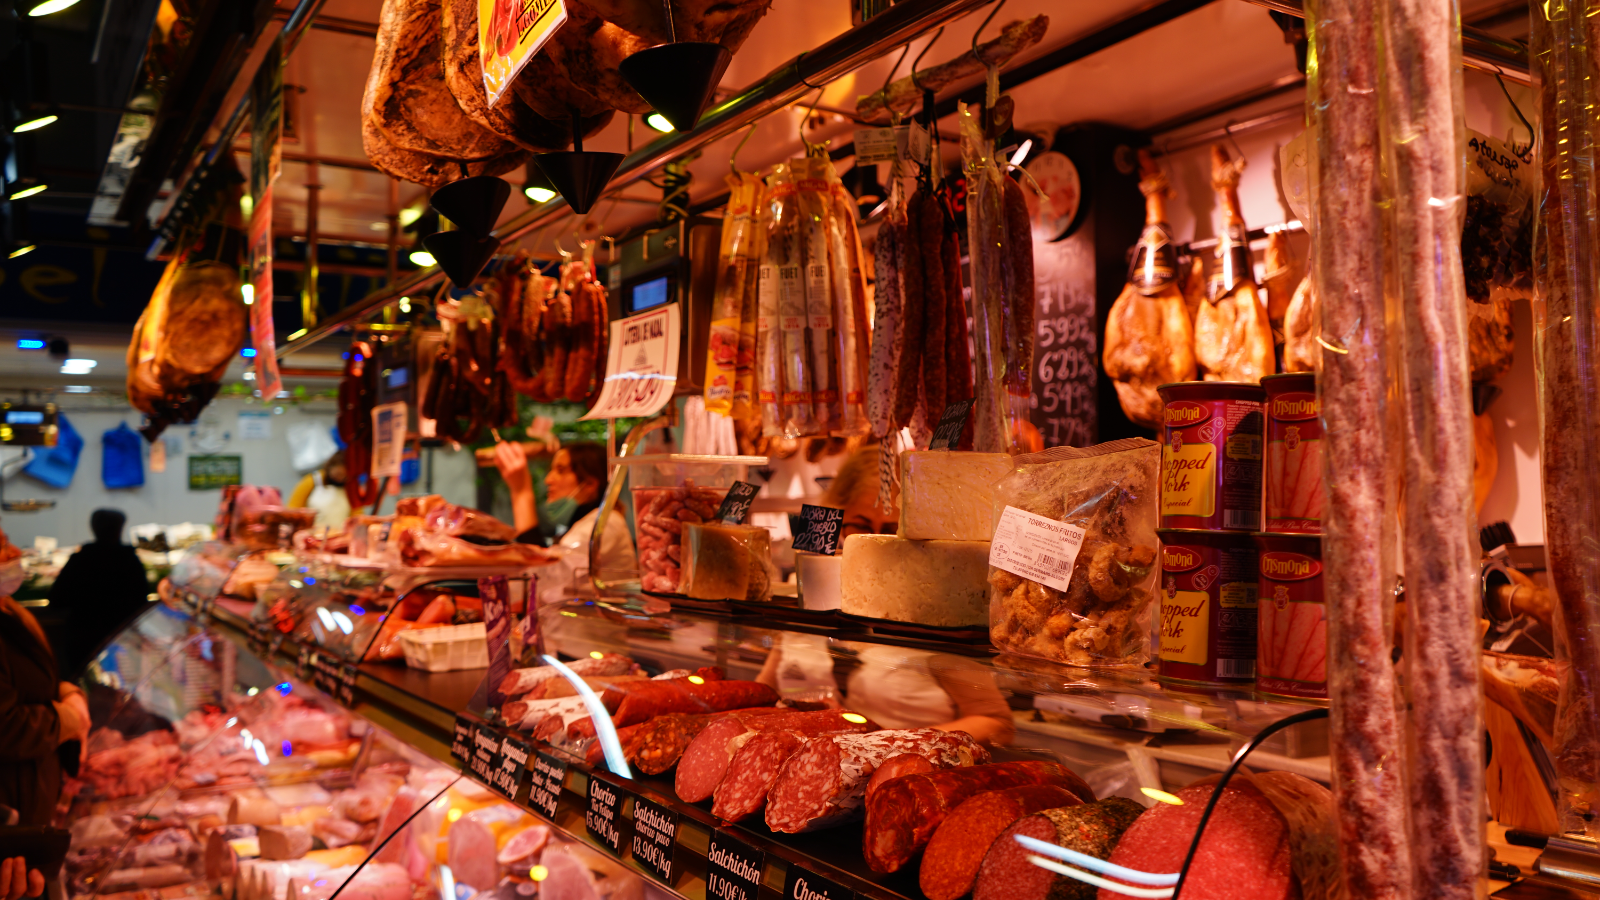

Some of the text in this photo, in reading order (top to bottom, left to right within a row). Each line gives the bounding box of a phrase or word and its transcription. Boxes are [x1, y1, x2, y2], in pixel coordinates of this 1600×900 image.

[1027, 518, 1082, 540] TORREZNOS FRITOS
[1262, 556, 1310, 575] Crismona
[590, 780, 616, 806] Chorizo
[586, 810, 619, 848] 15.90€/kg
[633, 801, 675, 837] Salchichón
[635, 820, 656, 838] chorizo
[632, 836, 671, 879] 13.90€/kg
[708, 842, 761, 885] Salchichón
[708, 873, 749, 900] 11.90€/k
